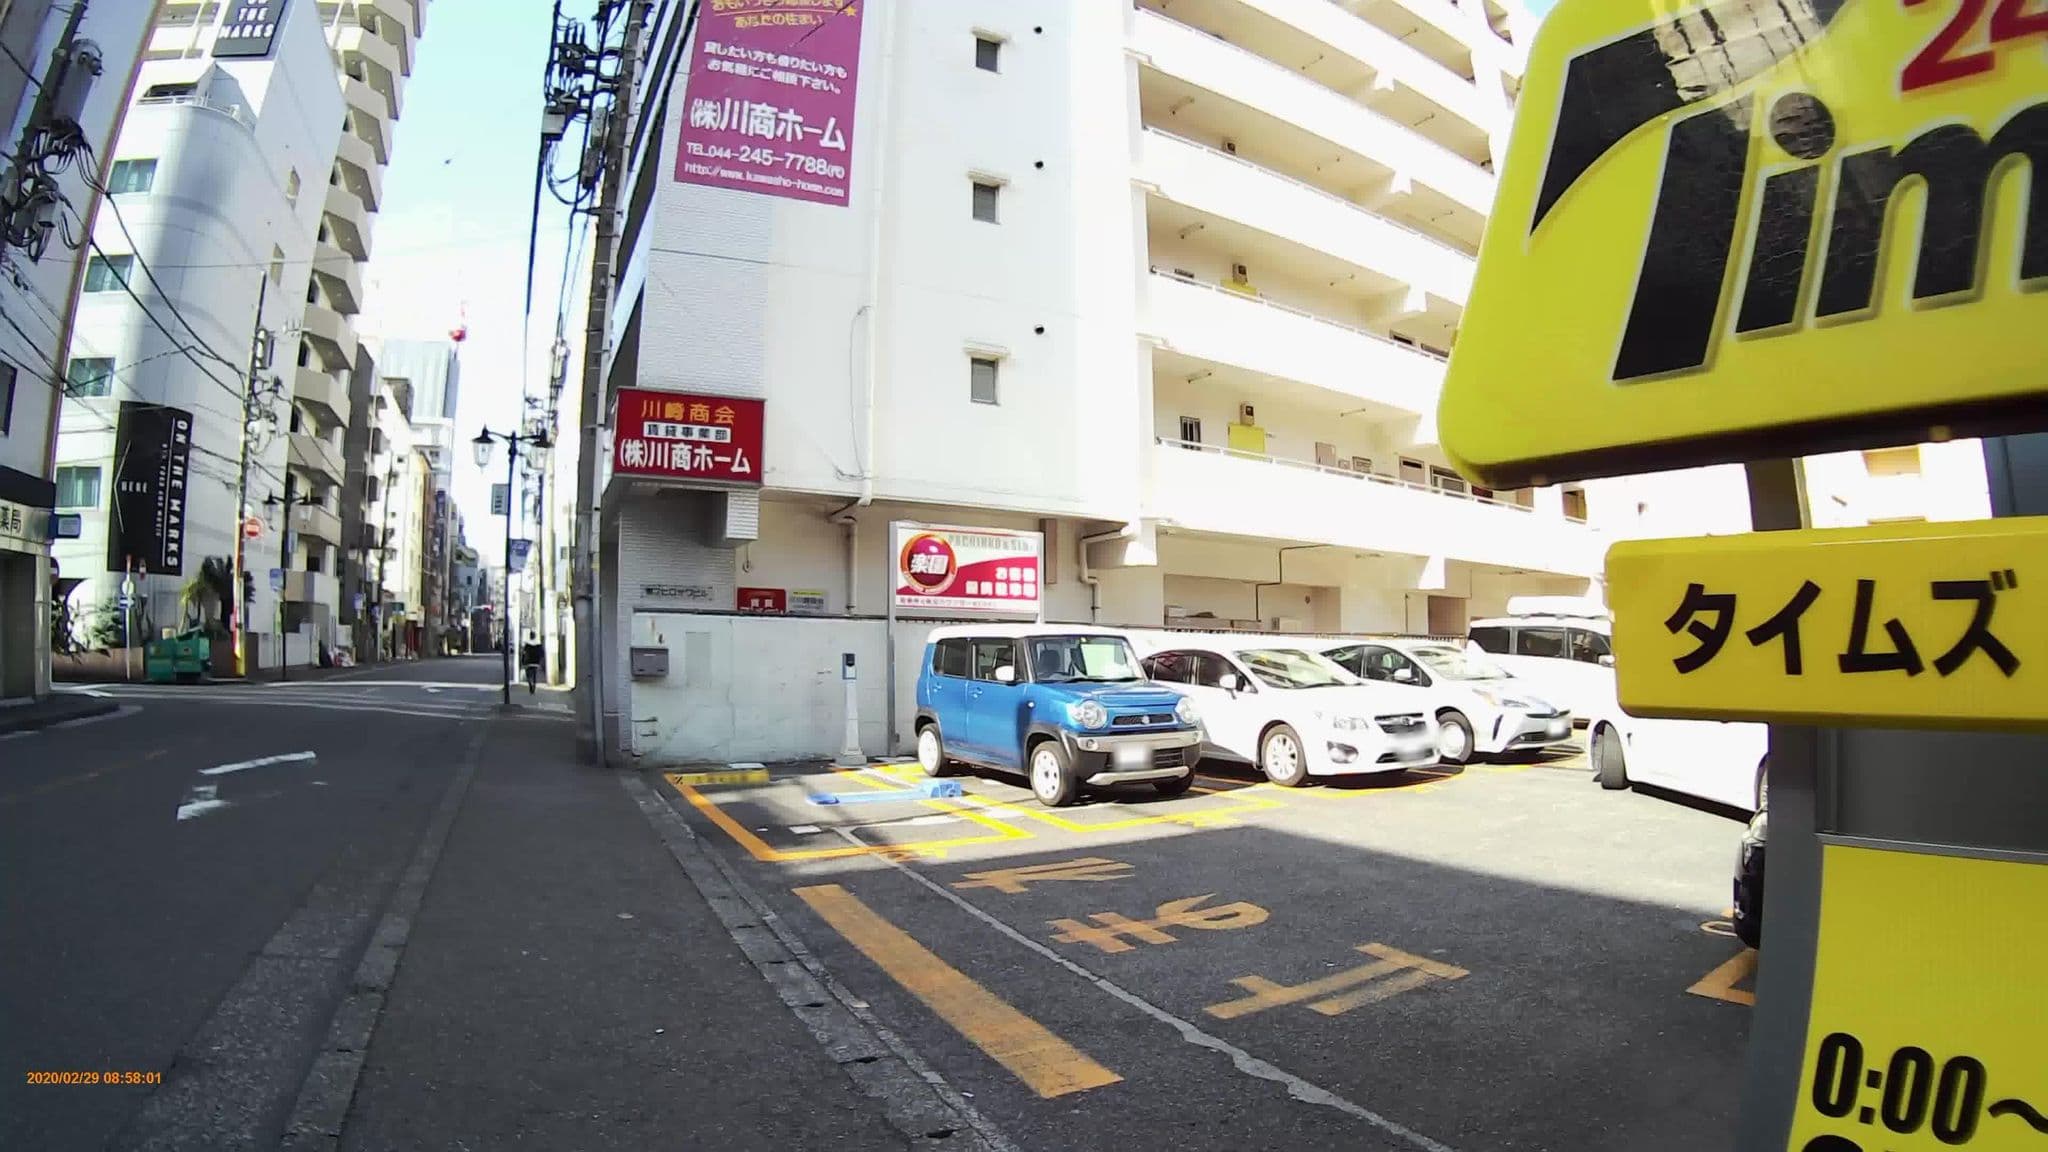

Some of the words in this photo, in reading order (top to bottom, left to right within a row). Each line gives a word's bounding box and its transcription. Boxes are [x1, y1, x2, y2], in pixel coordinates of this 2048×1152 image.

[219, 23, 275, 39] MARKS
[238, 7, 268, 22] THE
[175, 420, 188, 444] ON
[171, 454, 185, 490] THE
[620, 439, 752, 474] (株)川商ホーム
[166, 499, 182, 567] MARKS
[1665, 568, 2021, 678] タイムズ
